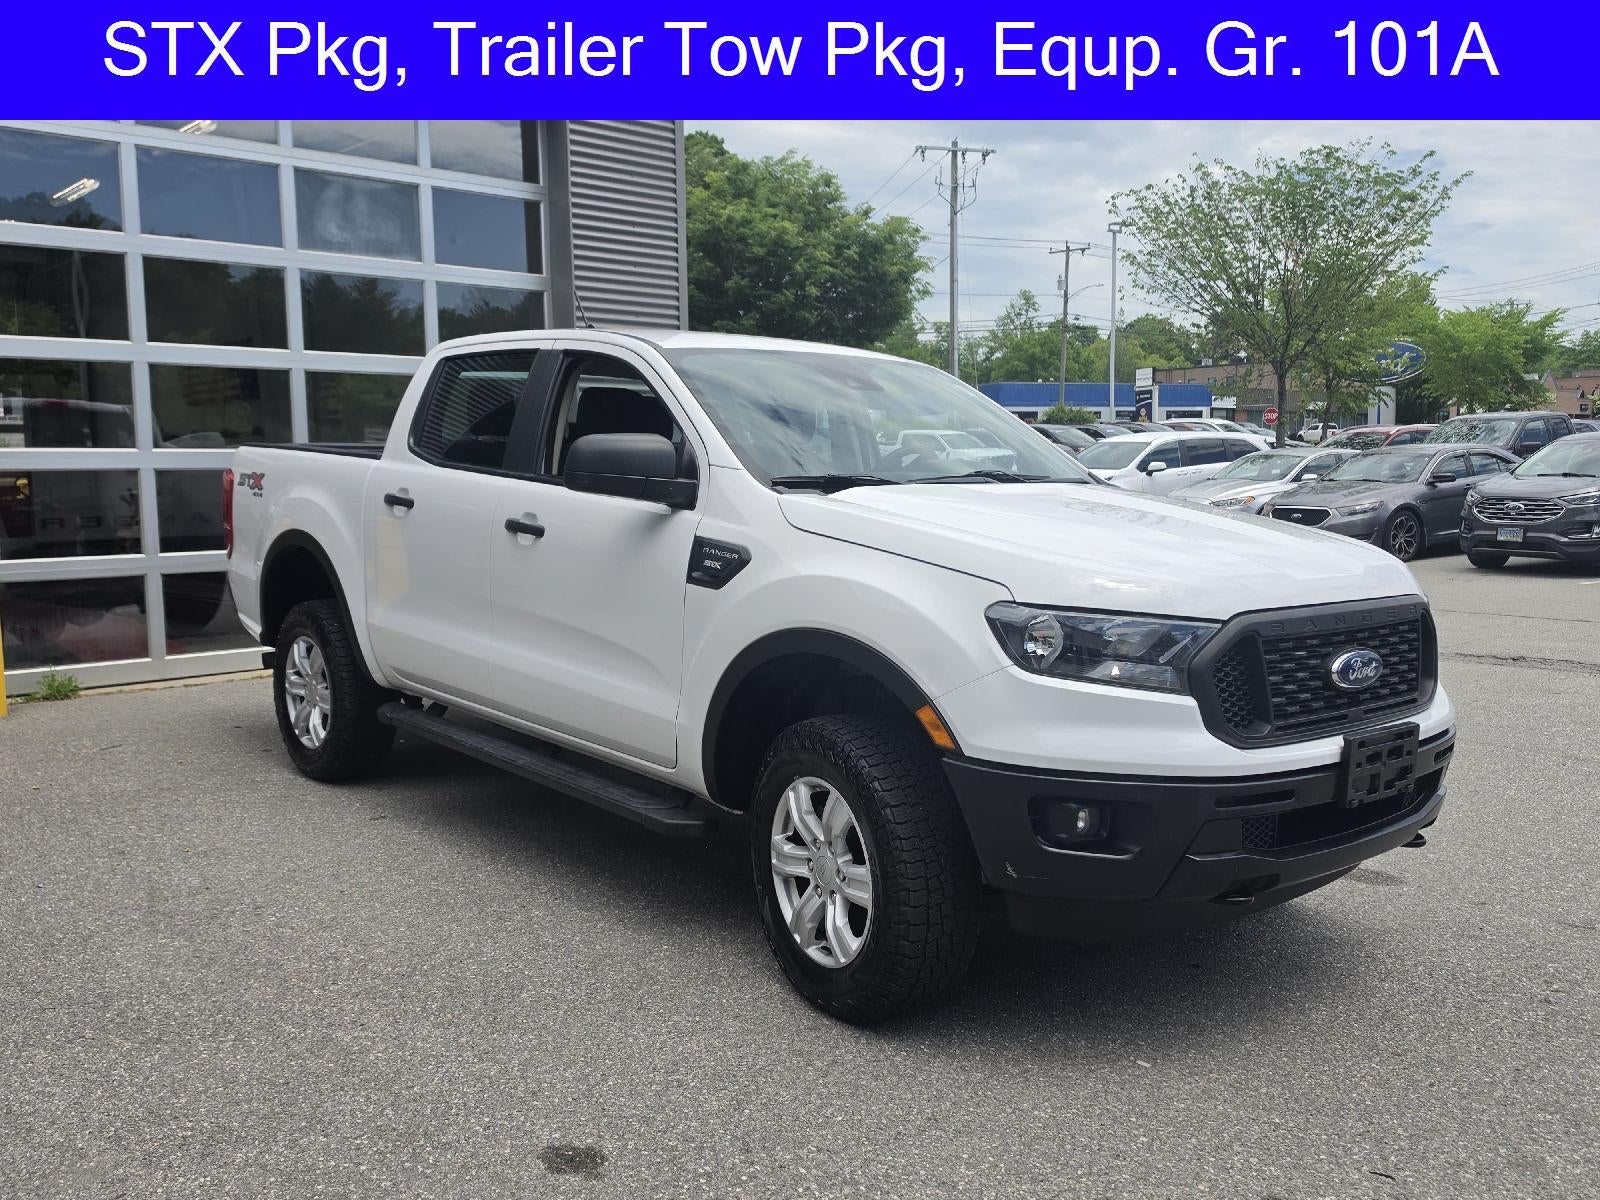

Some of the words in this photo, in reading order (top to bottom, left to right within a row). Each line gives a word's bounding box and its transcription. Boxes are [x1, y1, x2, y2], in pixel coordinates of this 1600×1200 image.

[1264, 412, 1279, 420] STOP
[237, 472, 265, 491] STX
[702, 547, 739, 560] RANGER
[703, 559, 722, 570] STX
[1271, 604, 1419, 635] RANGER
[1348, 657, 1379, 681] Ford
